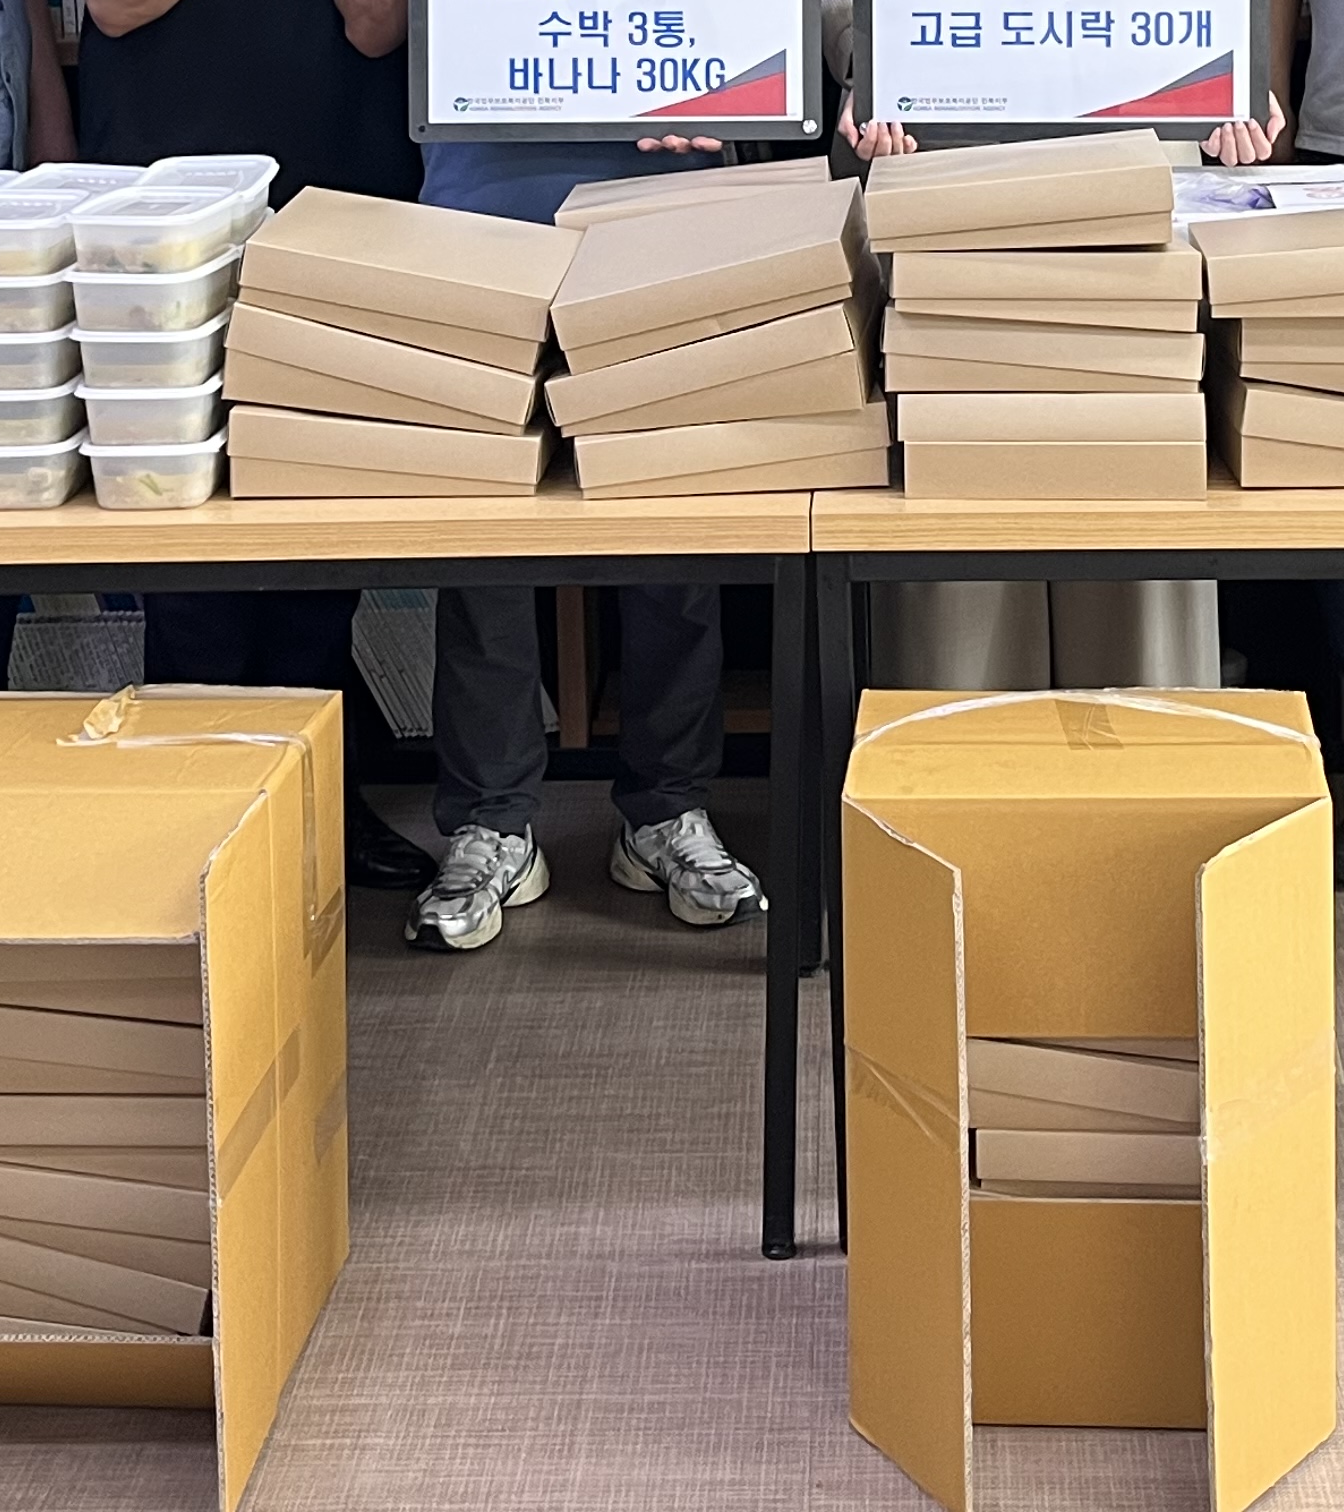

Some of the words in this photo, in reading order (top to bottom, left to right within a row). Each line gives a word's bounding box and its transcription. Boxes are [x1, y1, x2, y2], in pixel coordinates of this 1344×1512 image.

[537, 10, 613, 48] 수박
[627, 10, 696, 48] 3통,
[910, 10, 983, 48] 고급
[1000, 10, 1116, 48] 도시락
[1130, 10, 1213, 48] 30개
[508, 57, 621, 95] 바나나
[635, 57, 726, 93] 30KG
